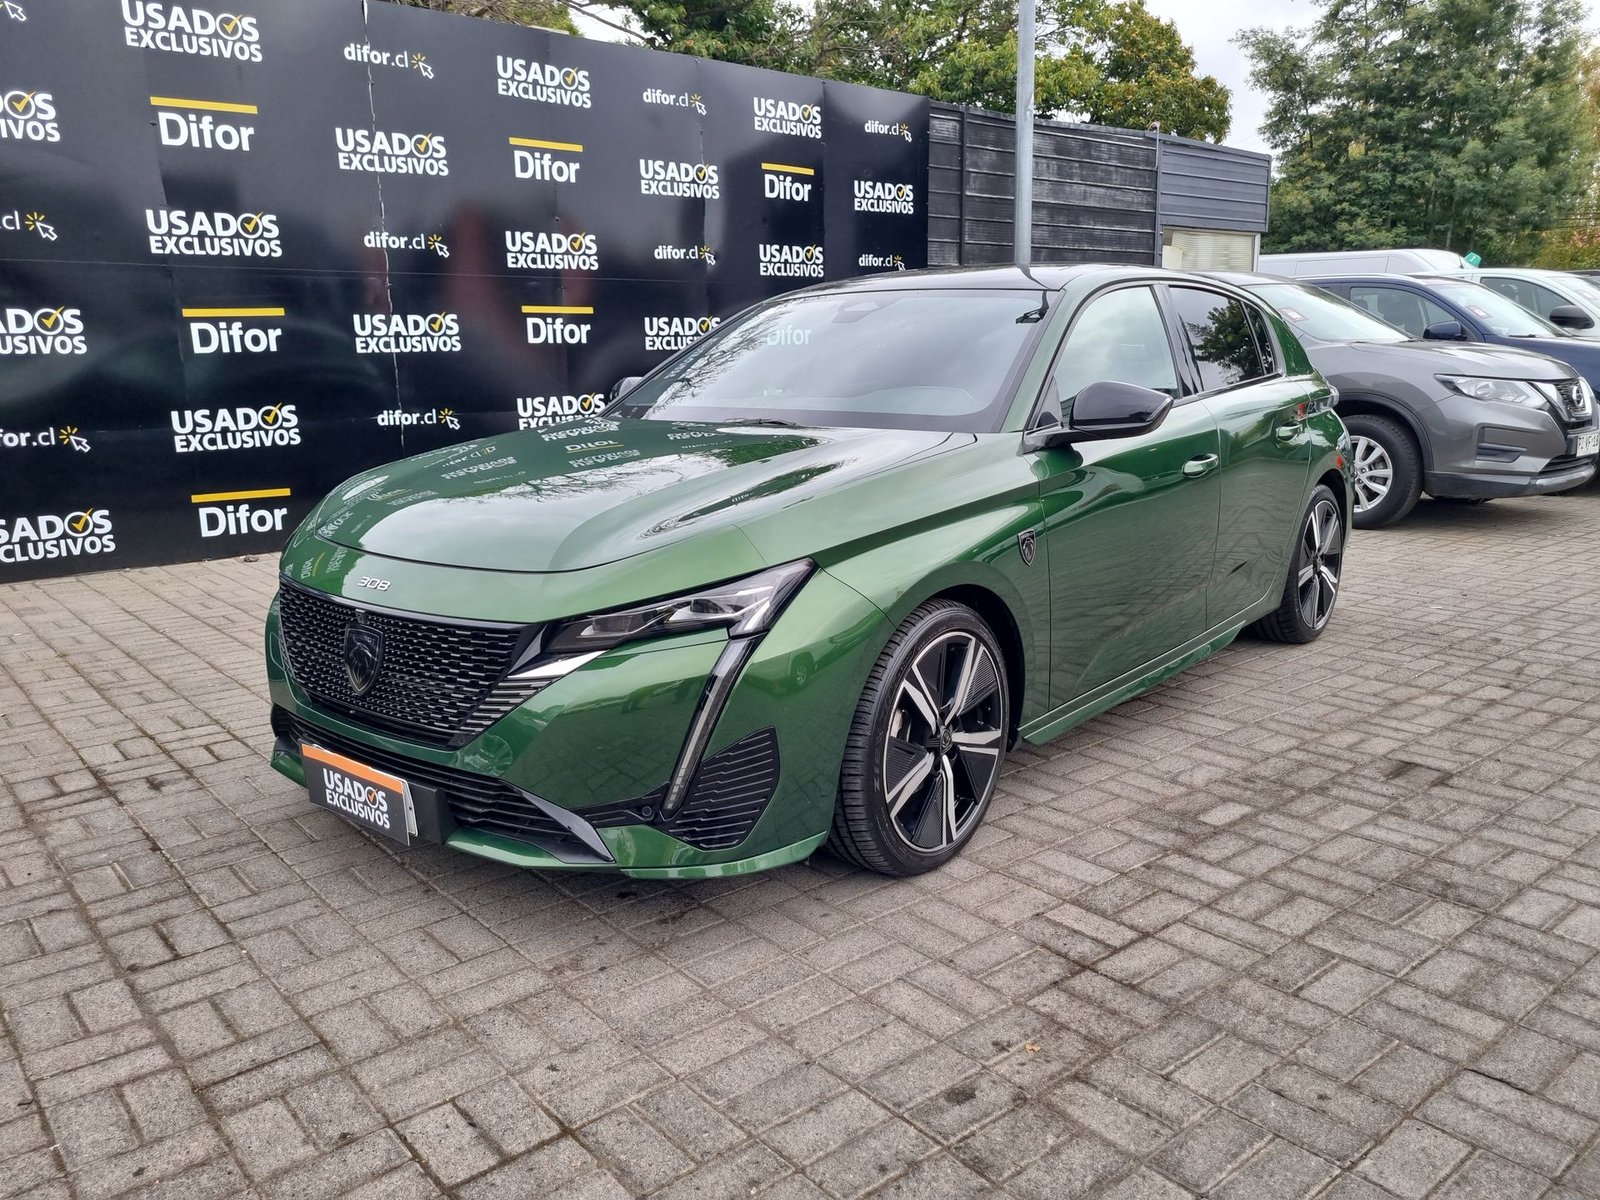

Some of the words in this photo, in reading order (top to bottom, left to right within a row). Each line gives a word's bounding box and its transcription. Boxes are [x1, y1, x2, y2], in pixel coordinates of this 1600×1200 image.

[121, 0, 259, 42] USADOS
[124, 26, 263, 63] EXCLUSIVOS
[344, 43, 408, 68] difor.cl
[497, 55, 590, 93] USADOS
[497, 79, 591, 109] EXCLUSIVOS
[643, 88, 688, 107] difor.cl
[753, 97, 821, 125] USADOS
[157, 111, 255, 152] Difor
[754, 117, 822, 139] EXCLUSIVOS
[865, 119, 899, 136] difor.cl
[335, 127, 447, 159] USADOS
[338, 152, 449, 177] EXCLUSIVOS
[513, 150, 580, 183] Difor
[639, 159, 719, 184] USADOS
[640, 179, 719, 199] EXCLUSIVOS
[764, 174, 811, 202] Difor
[854, 180, 913, 202] USADOS
[854, 197, 914, 214] EXCLUSIVOS
[145, 209, 279, 239] USADOS
[149, 235, 282, 258] EXCLUSIVOS
[363, 231, 425, 251] difor.cl
[505, 230, 597, 255] USADOS
[654, 244, 698, 260] difor.cl
[506, 252, 598, 271] EXCLUSIVOS
[759, 244, 824, 265] USADOS
[858, 254, 893, 268] difor.cl
[759, 260, 824, 277] EXCLUSIVOS
[0, 308, 84, 335] DOS
[353, 313, 459, 337] USADOS
[526, 317, 591, 344] Difor
[190, 322, 282, 354] Difor
[355, 336, 461, 353] EXCLUSIVOS
[377, 408, 437, 427] difor.cl
[517, 393, 605, 417] USADOS
[171, 404, 299, 434] USADOS
[174, 429, 301, 453] EXCLUSIVOS
[199, 505, 287, 537] Difor
[357, 577, 391, 591] 308
[323, 768, 387, 812] USADOS
[326, 787, 390, 829] EXCLUSIVOS
